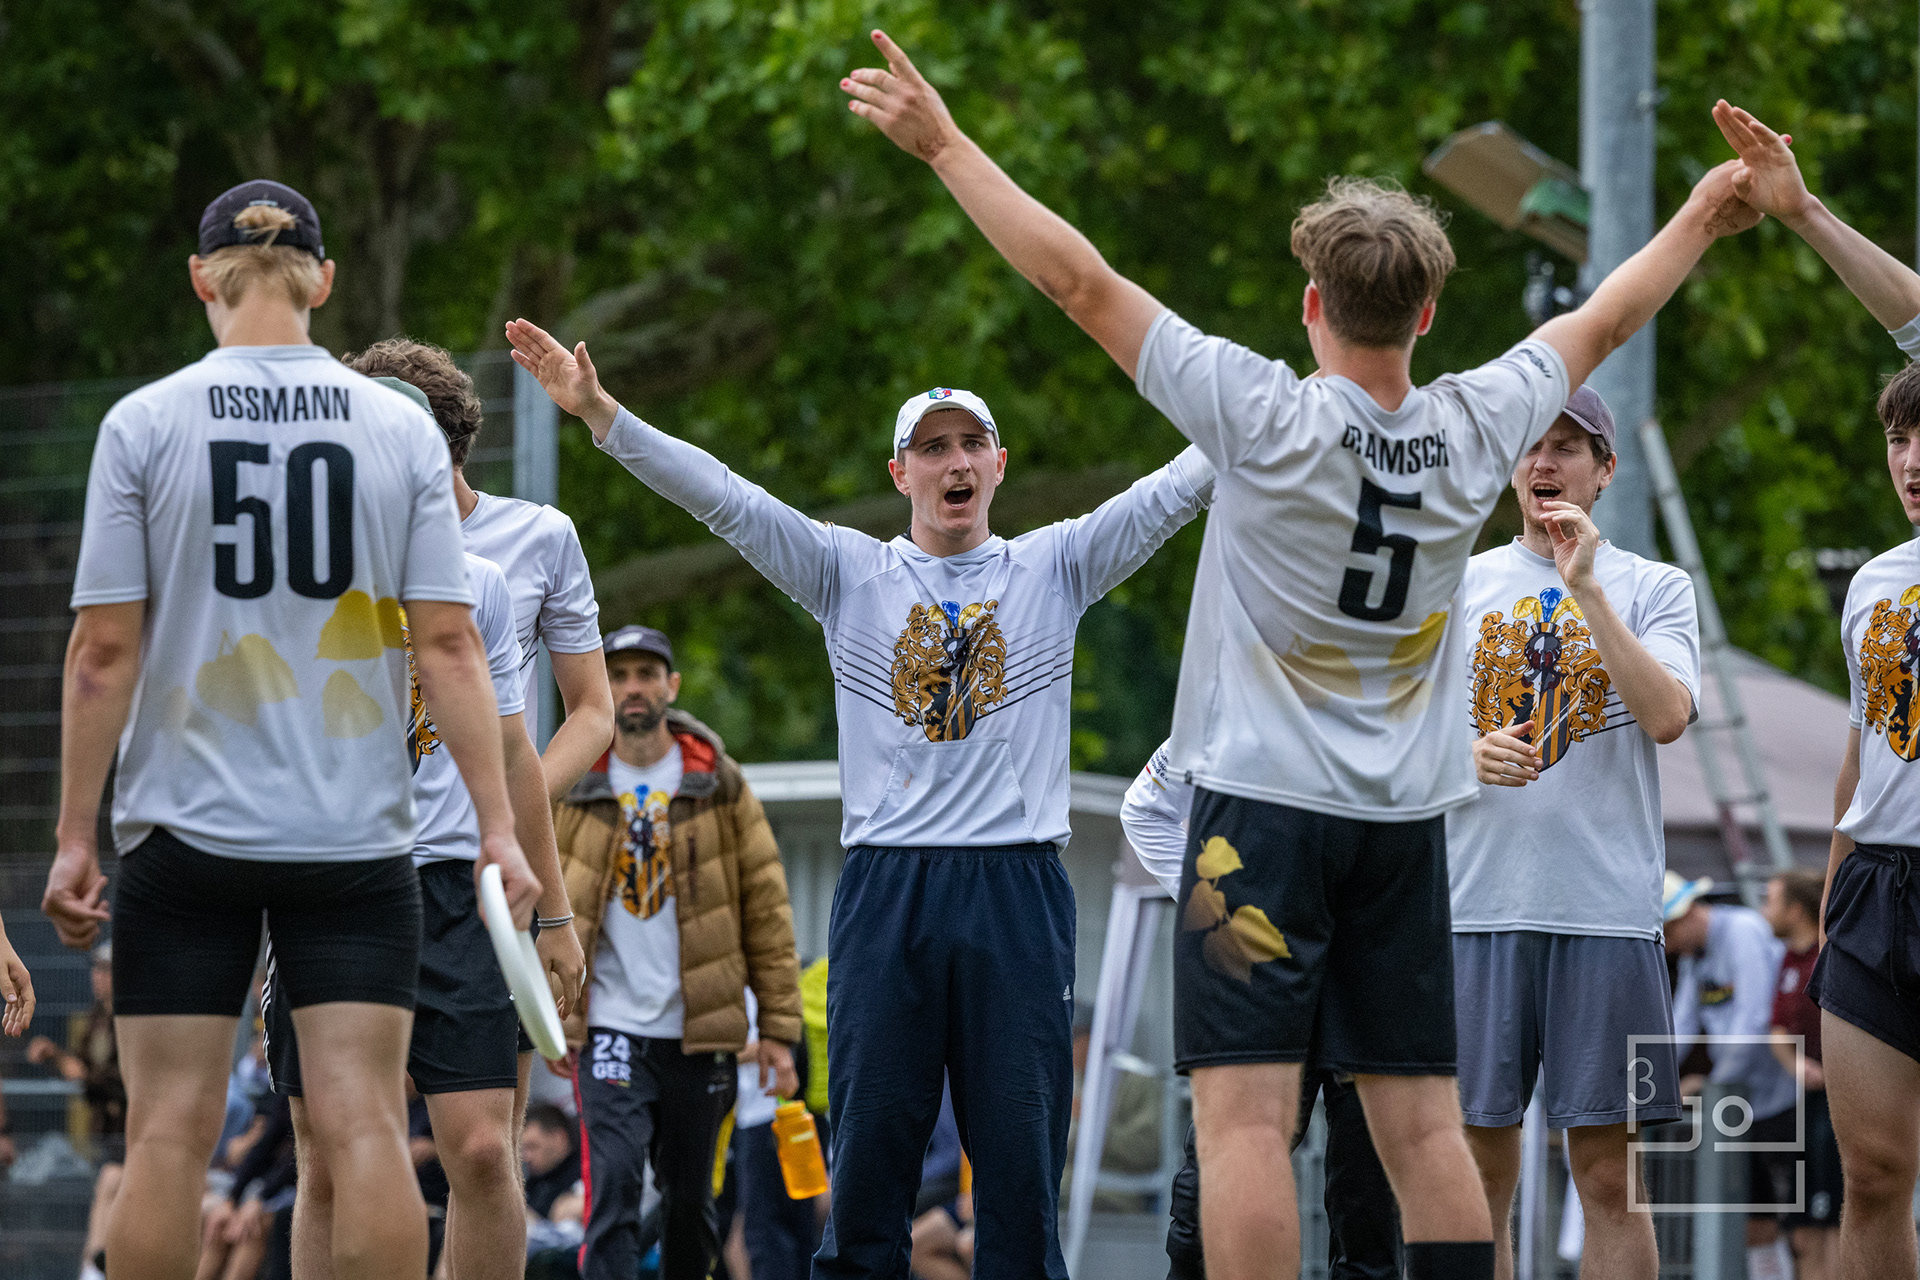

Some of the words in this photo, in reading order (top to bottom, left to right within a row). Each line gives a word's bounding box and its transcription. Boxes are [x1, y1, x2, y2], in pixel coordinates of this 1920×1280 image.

[208, 385, 350, 423] OSSMANN
[208, 441, 354, 599] 50
[1338, 477, 1421, 621] 5
[593, 1034, 631, 1061] 24
[592, 1062, 632, 1081] GER
